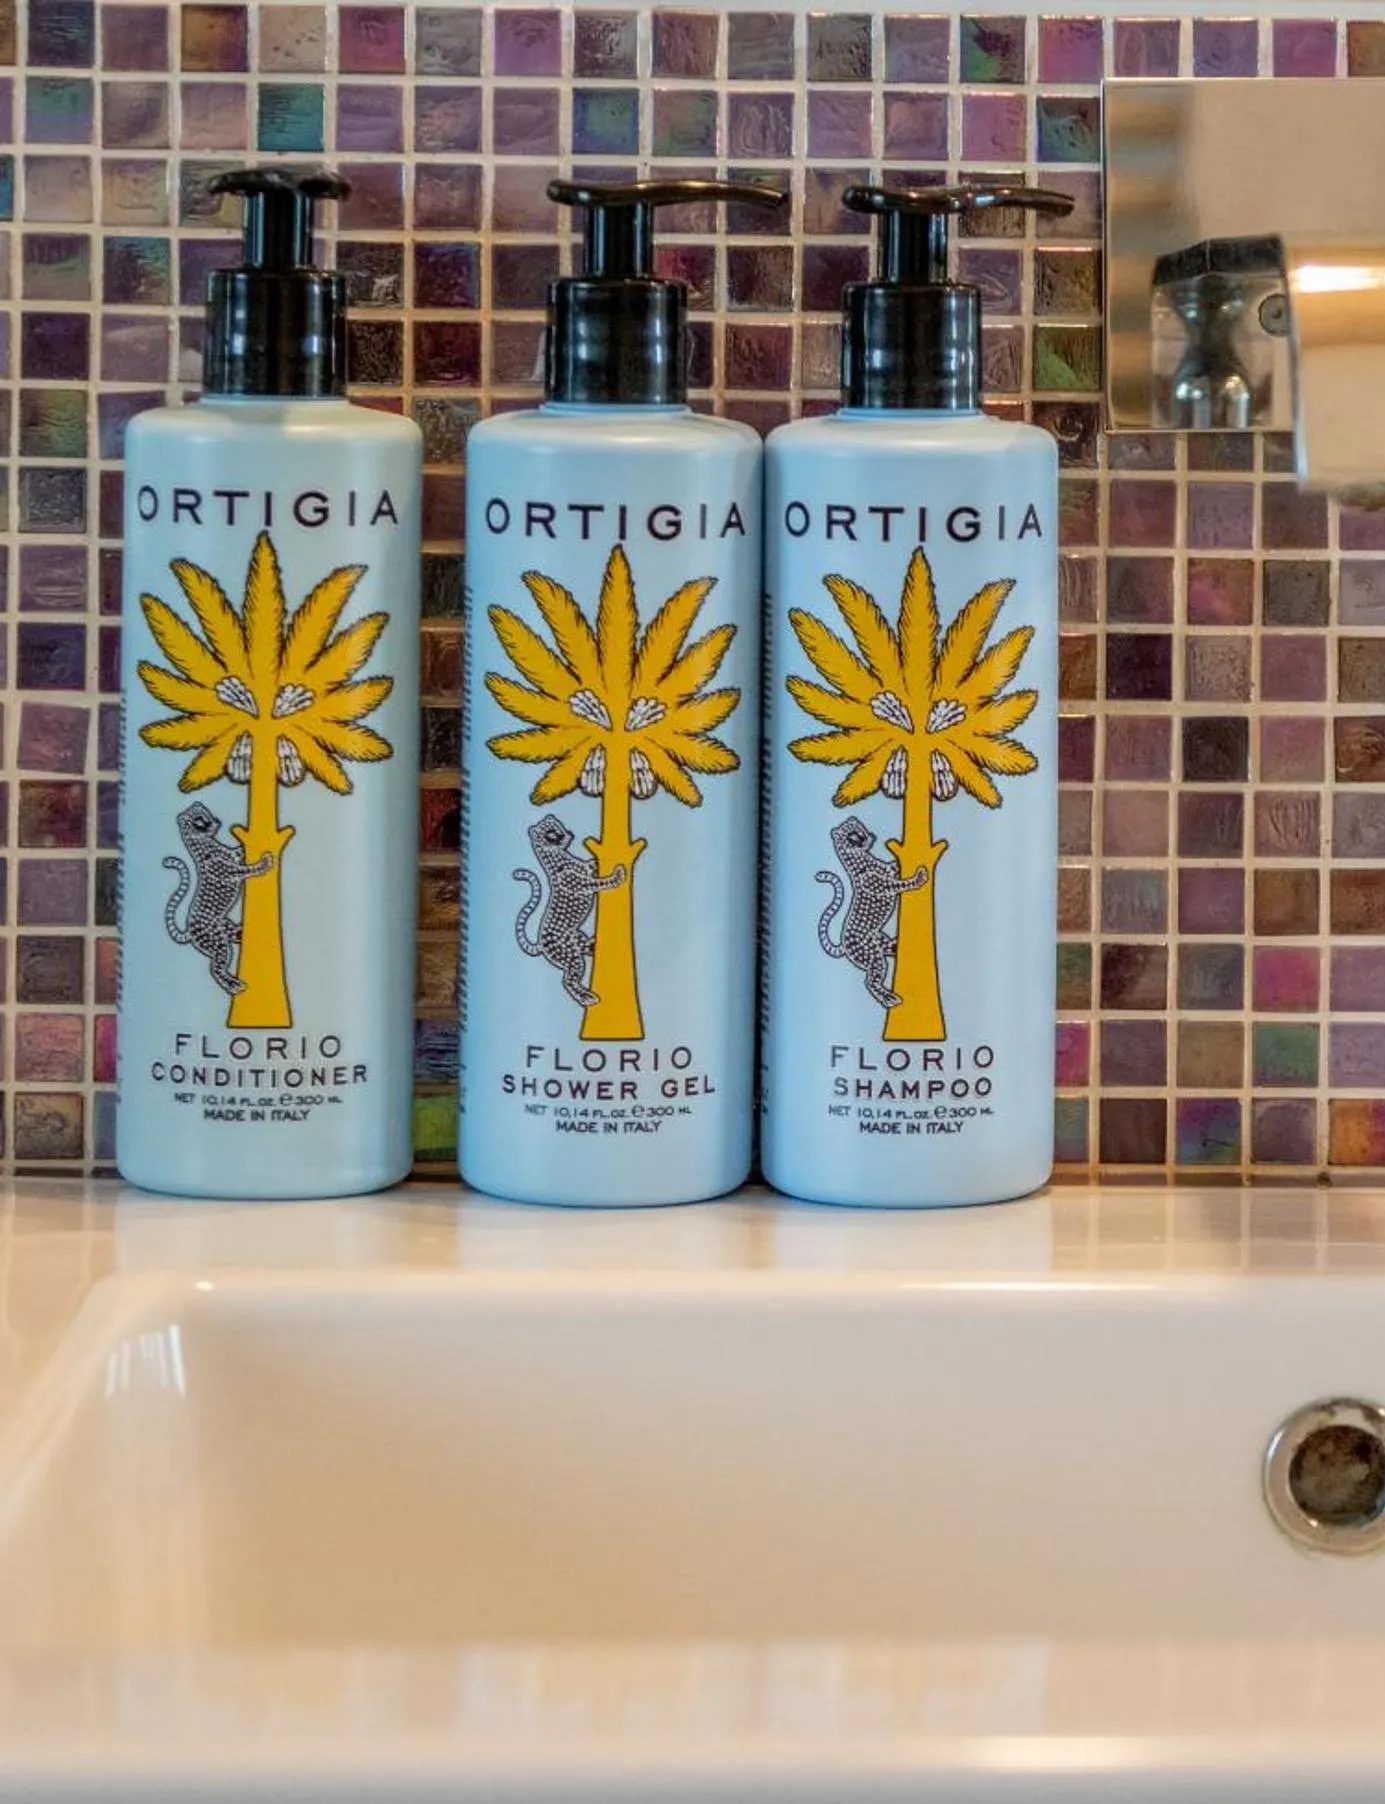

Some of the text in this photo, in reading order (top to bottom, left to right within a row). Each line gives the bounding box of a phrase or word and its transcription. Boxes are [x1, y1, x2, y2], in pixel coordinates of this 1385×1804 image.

[138, 485, 398, 527] ORTIGIA
[485, 497, 746, 541] ORTIGIA
[784, 501, 1043, 542] ORTIGIA
[175, 1033, 341, 1060] FLORIO
[526, 1045, 692, 1072] FLORIO
[830, 1045, 994, 1072] FLORIO
[151, 1061, 368, 1088] CONDITIONER
[502, 1074, 716, 1100] SHOWER GEL
[174, 1092, 196, 1103] NET
[833, 1077, 992, 1100] SHAMPOO
[203, 1109, 310, 1121] MADE IN ITALY
[524, 1104, 547, 1115] NET
[828, 1104, 850, 1116] NET
[556, 1120, 662, 1133] MADE IN ITALY
[860, 1121, 964, 1134] MADE IN ITALY
